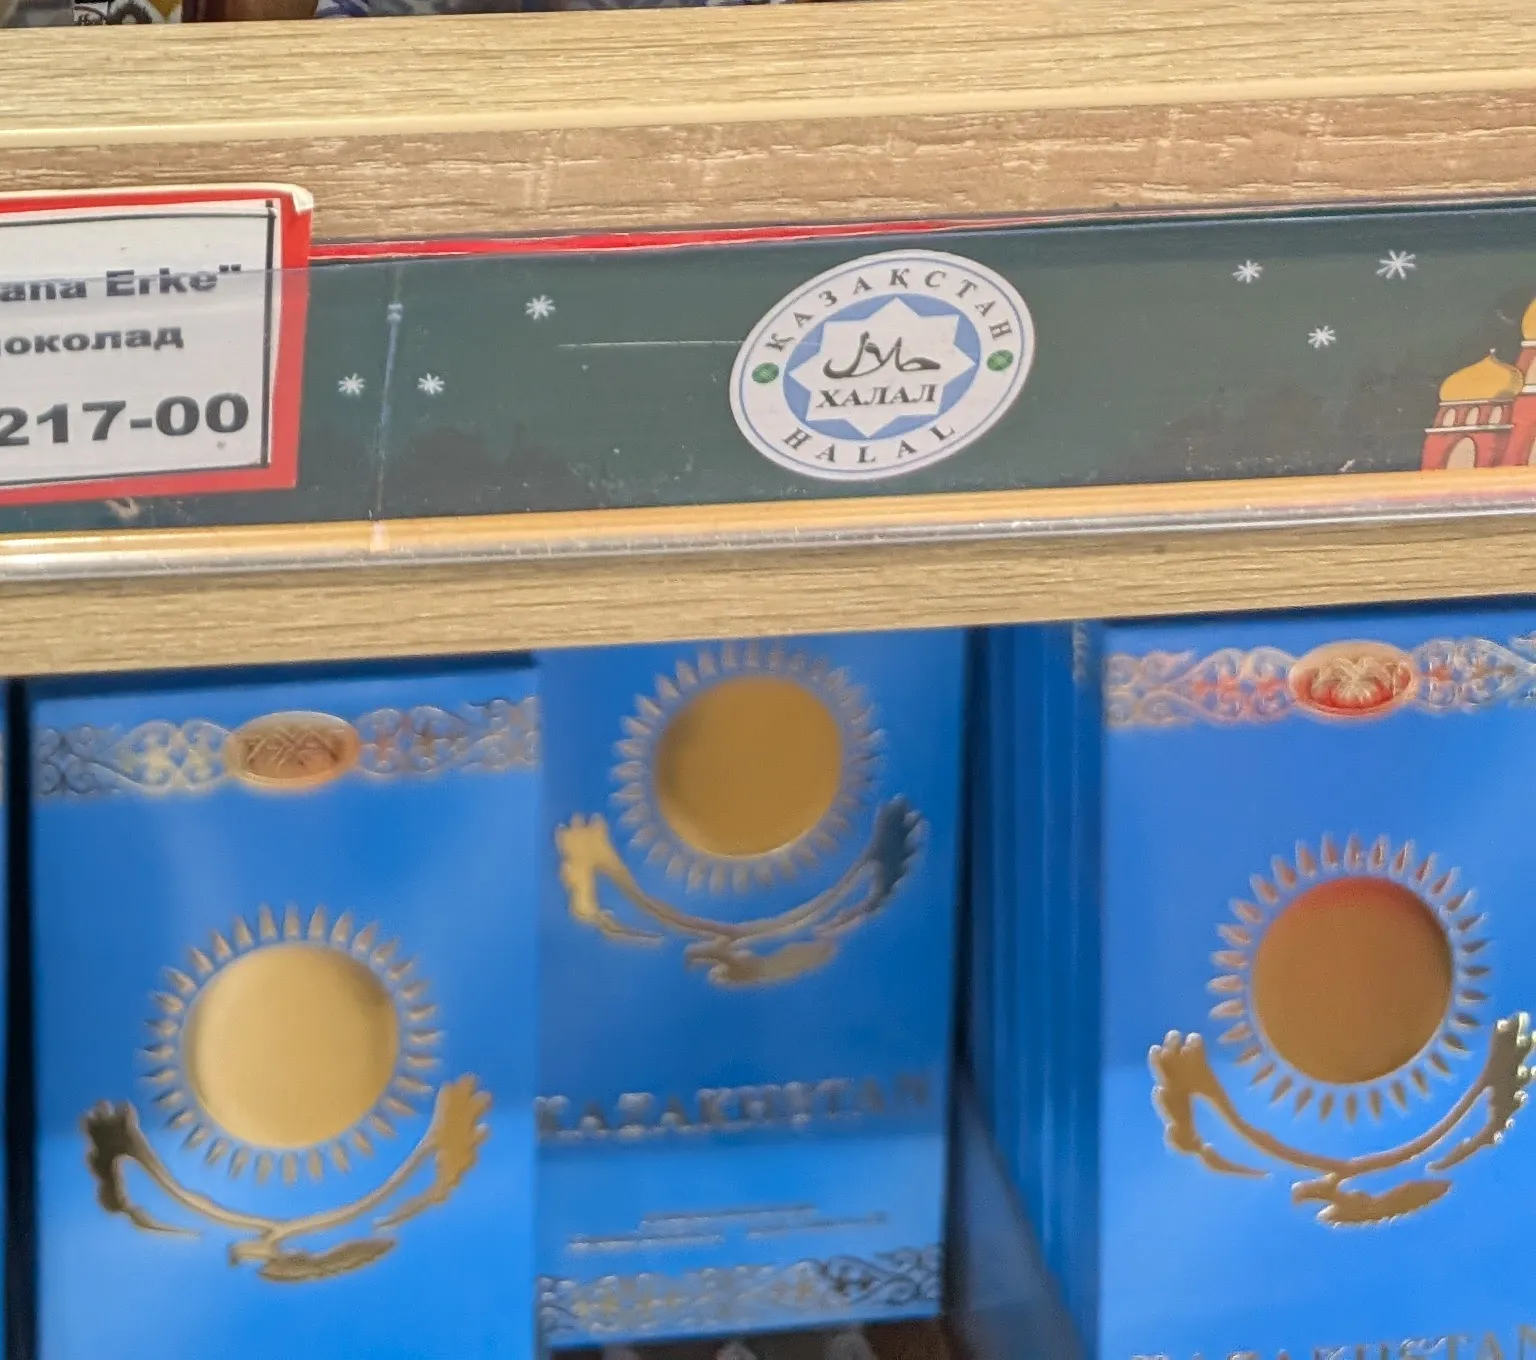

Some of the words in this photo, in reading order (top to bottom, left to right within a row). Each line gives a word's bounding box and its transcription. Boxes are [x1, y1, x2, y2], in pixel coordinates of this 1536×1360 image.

[765, 267, 1013, 352] ҚАЗАҚСТАН
[815, 383, 939, 409] ХАЛАЛ
[781, 425, 955, 464] HALAL
